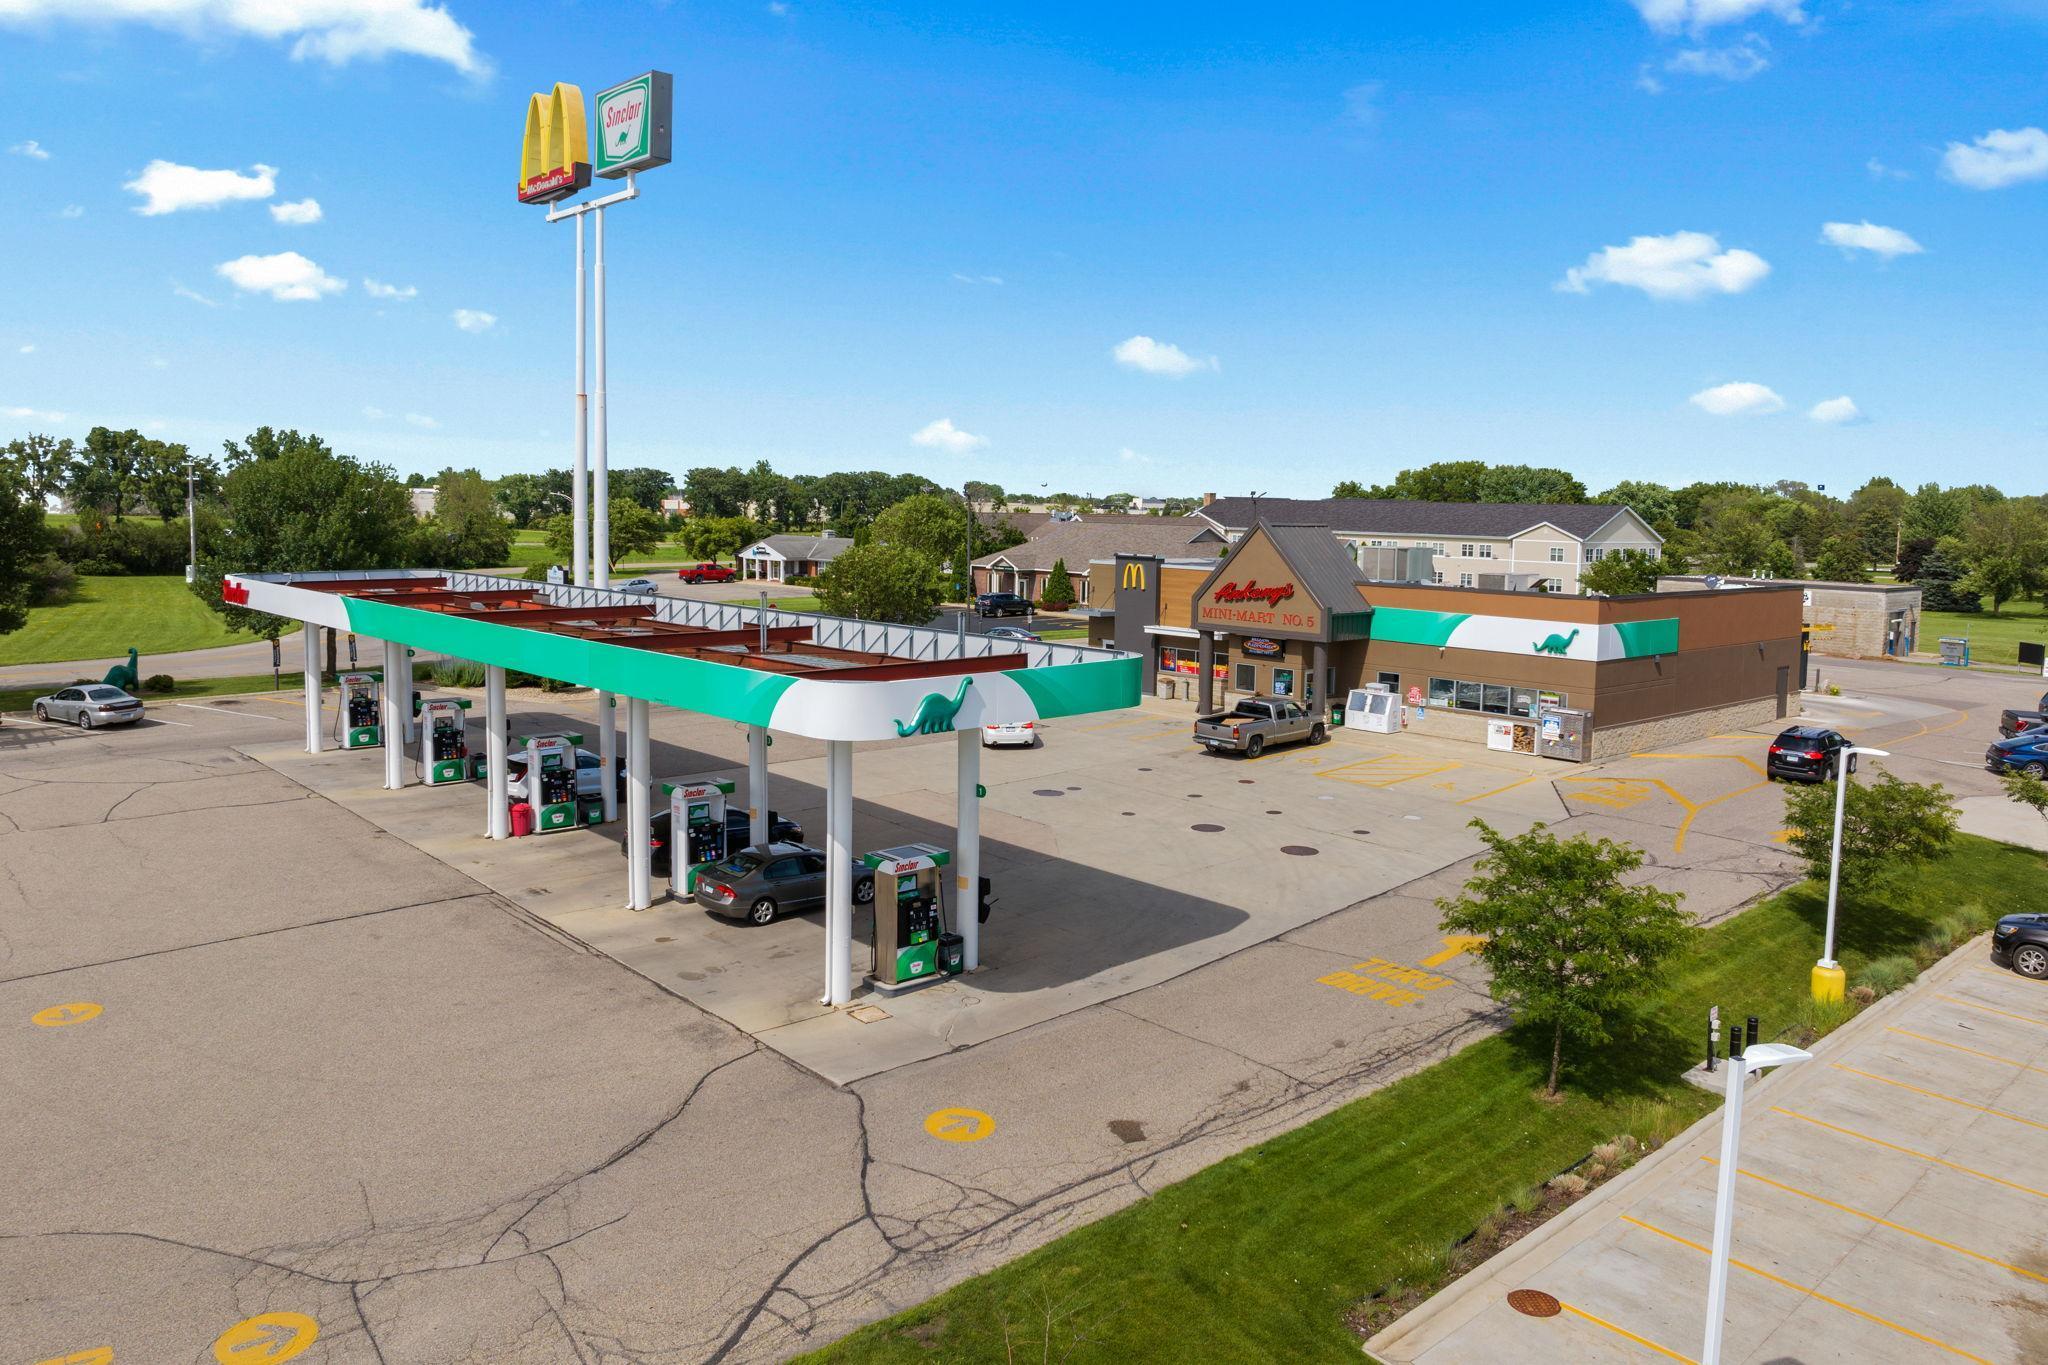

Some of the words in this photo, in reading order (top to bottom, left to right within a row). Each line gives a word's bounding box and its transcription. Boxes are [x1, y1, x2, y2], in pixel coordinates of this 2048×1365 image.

[606, 99, 642, 127] Sinclair
[527, 175, 563, 195] McDonald's
[1202, 606, 1275, 624] MINI-MART
[1282, 613, 1304, 627] NO.
[1307, 616, 1315, 628] 5
[683, 787, 706, 798] Sinclair
[895, 860, 919, 873] Sinclair
